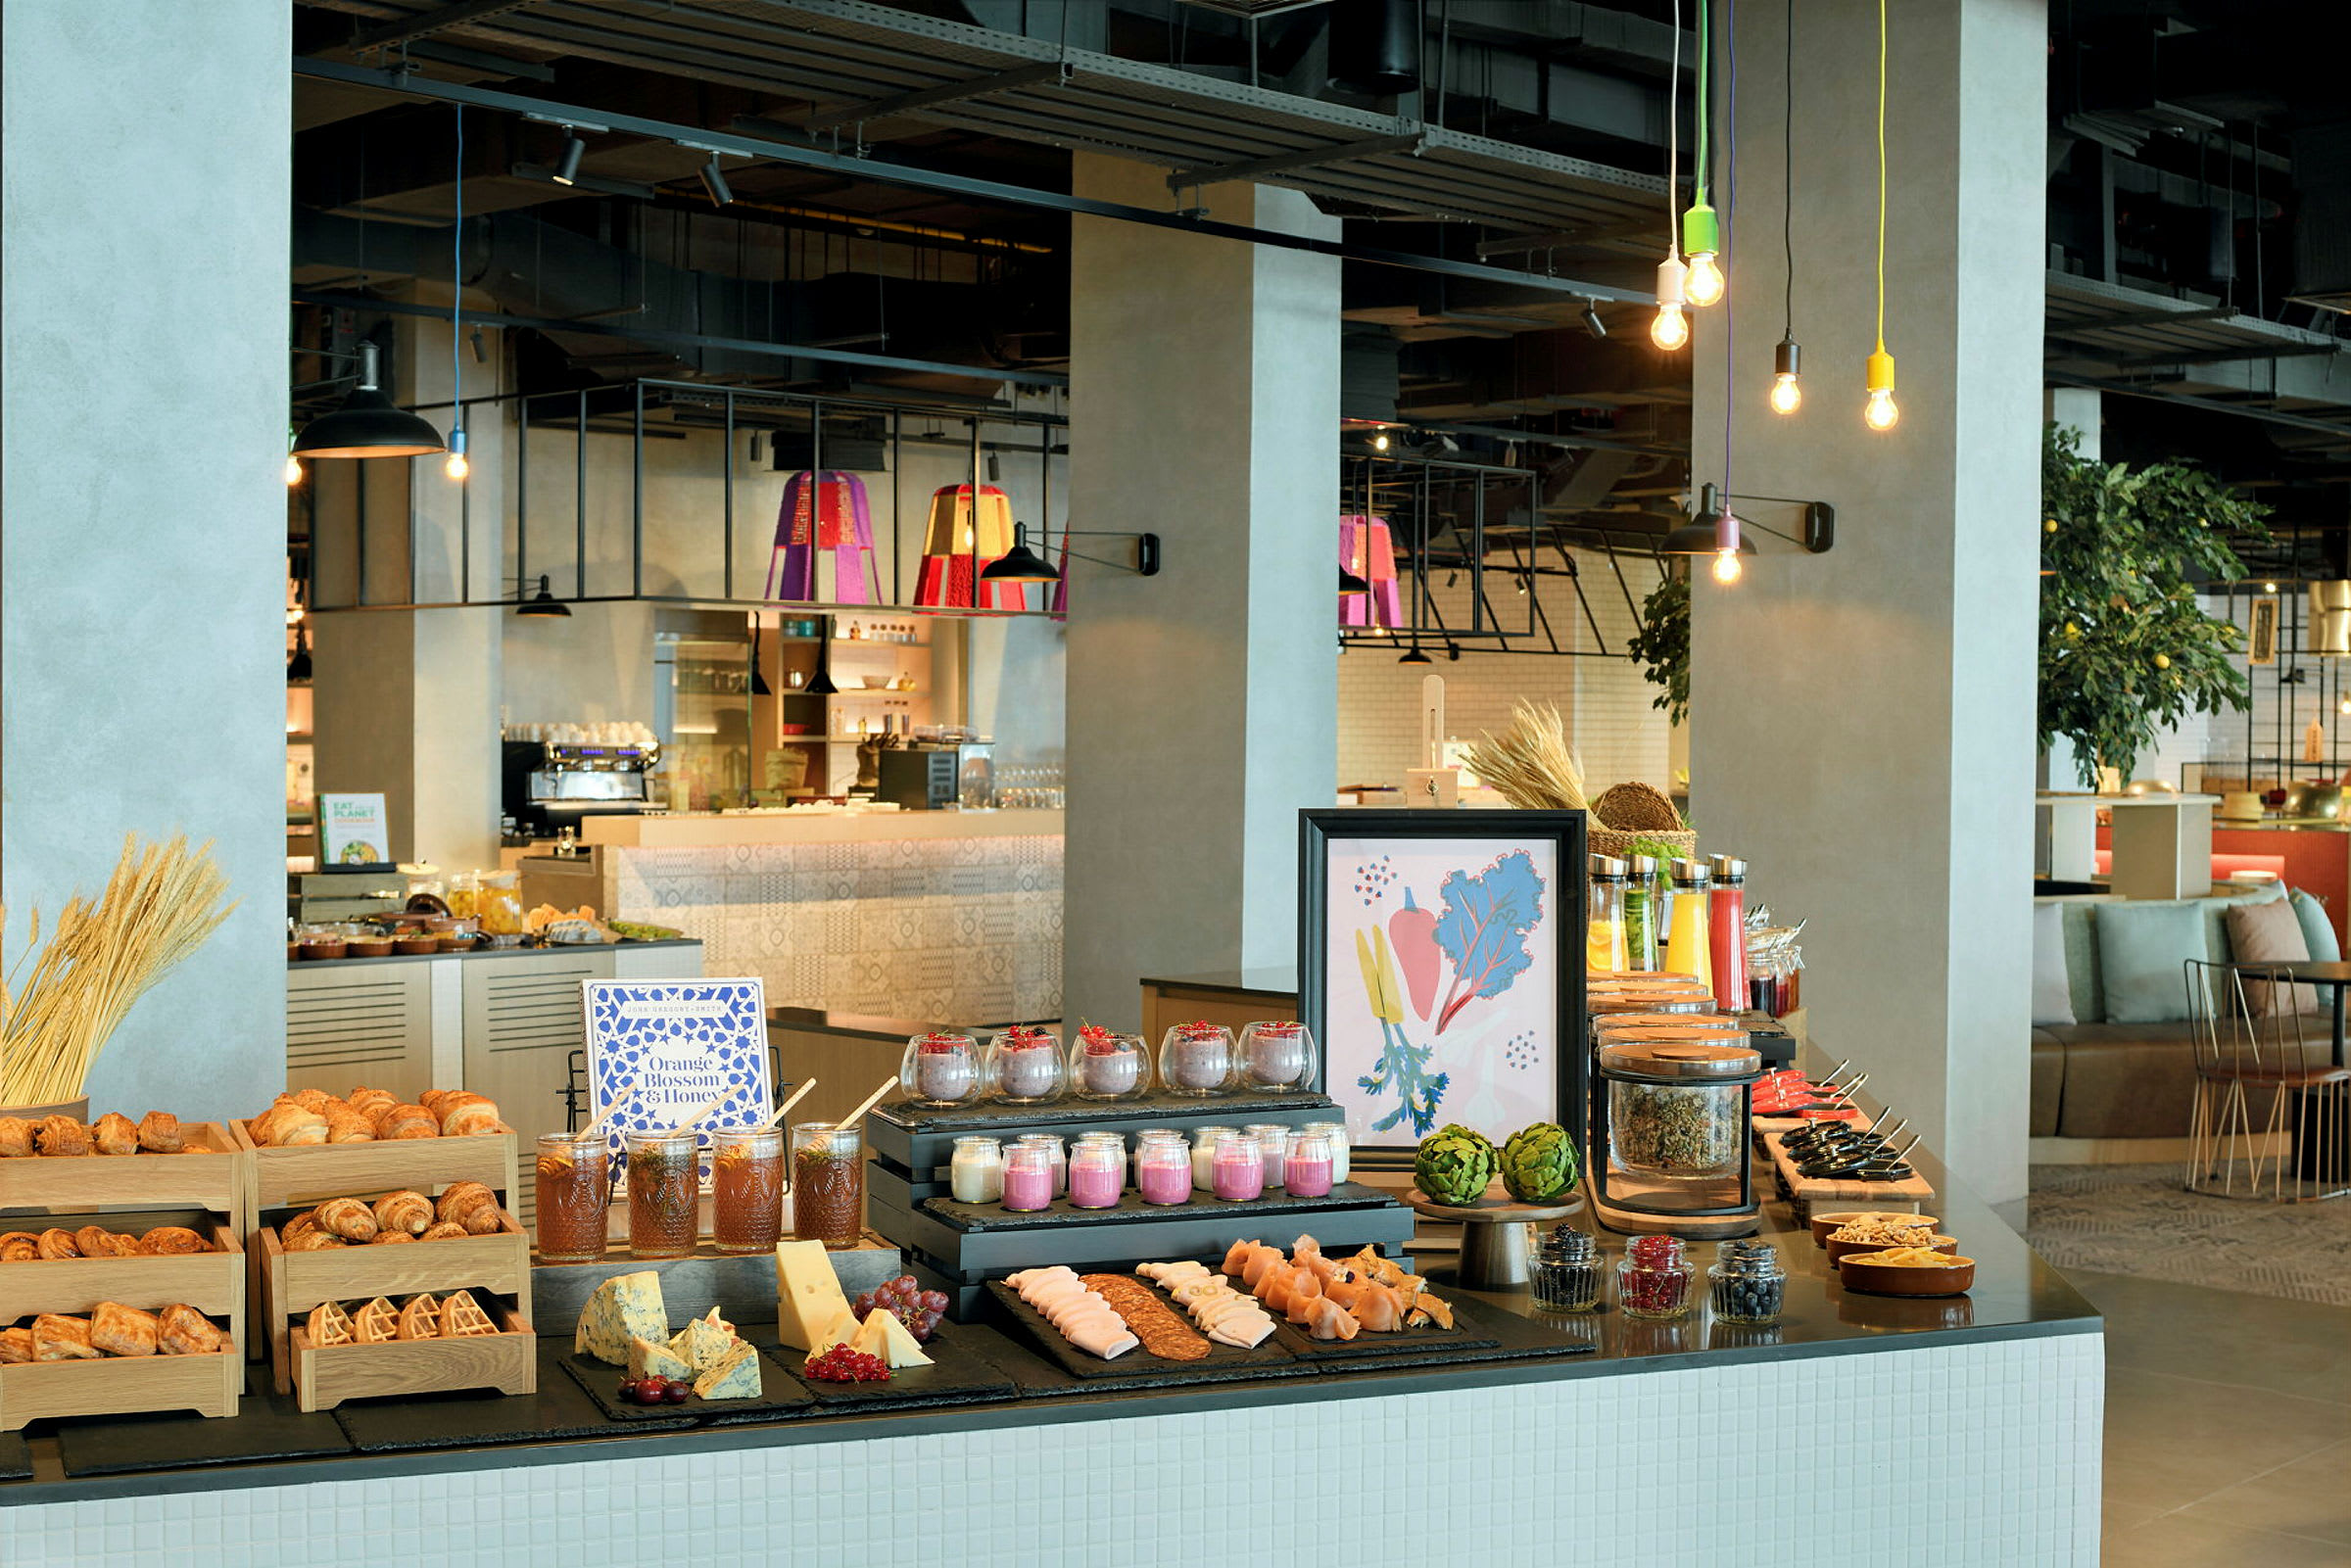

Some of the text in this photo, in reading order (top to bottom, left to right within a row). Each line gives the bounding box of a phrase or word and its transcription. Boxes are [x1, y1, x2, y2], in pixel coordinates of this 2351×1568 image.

[334, 808, 374, 817] PLANET
[648, 1056, 713, 1071] Orange
[645, 1073, 719, 1088] Blossom
